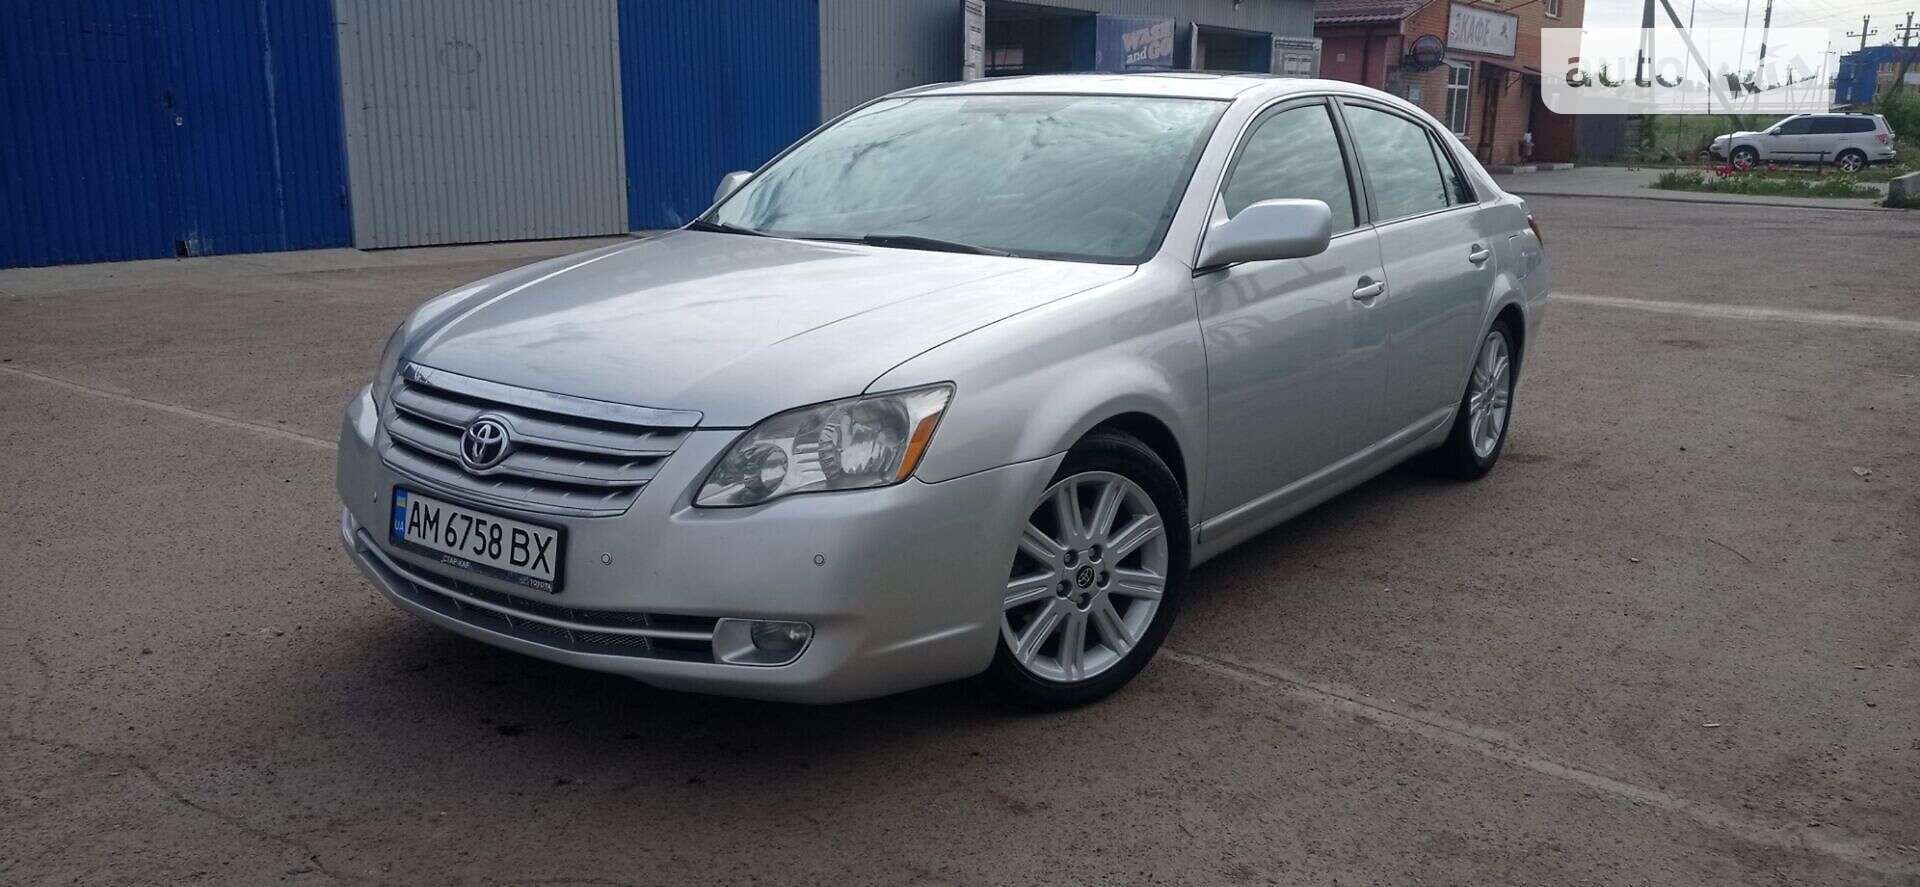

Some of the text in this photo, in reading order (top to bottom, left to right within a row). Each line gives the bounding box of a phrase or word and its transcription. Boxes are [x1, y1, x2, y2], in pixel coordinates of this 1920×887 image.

[1126, 46, 1147, 64] and
[394, 520, 405, 531] UA
[407, 501, 553, 574] AM 6758 BX
